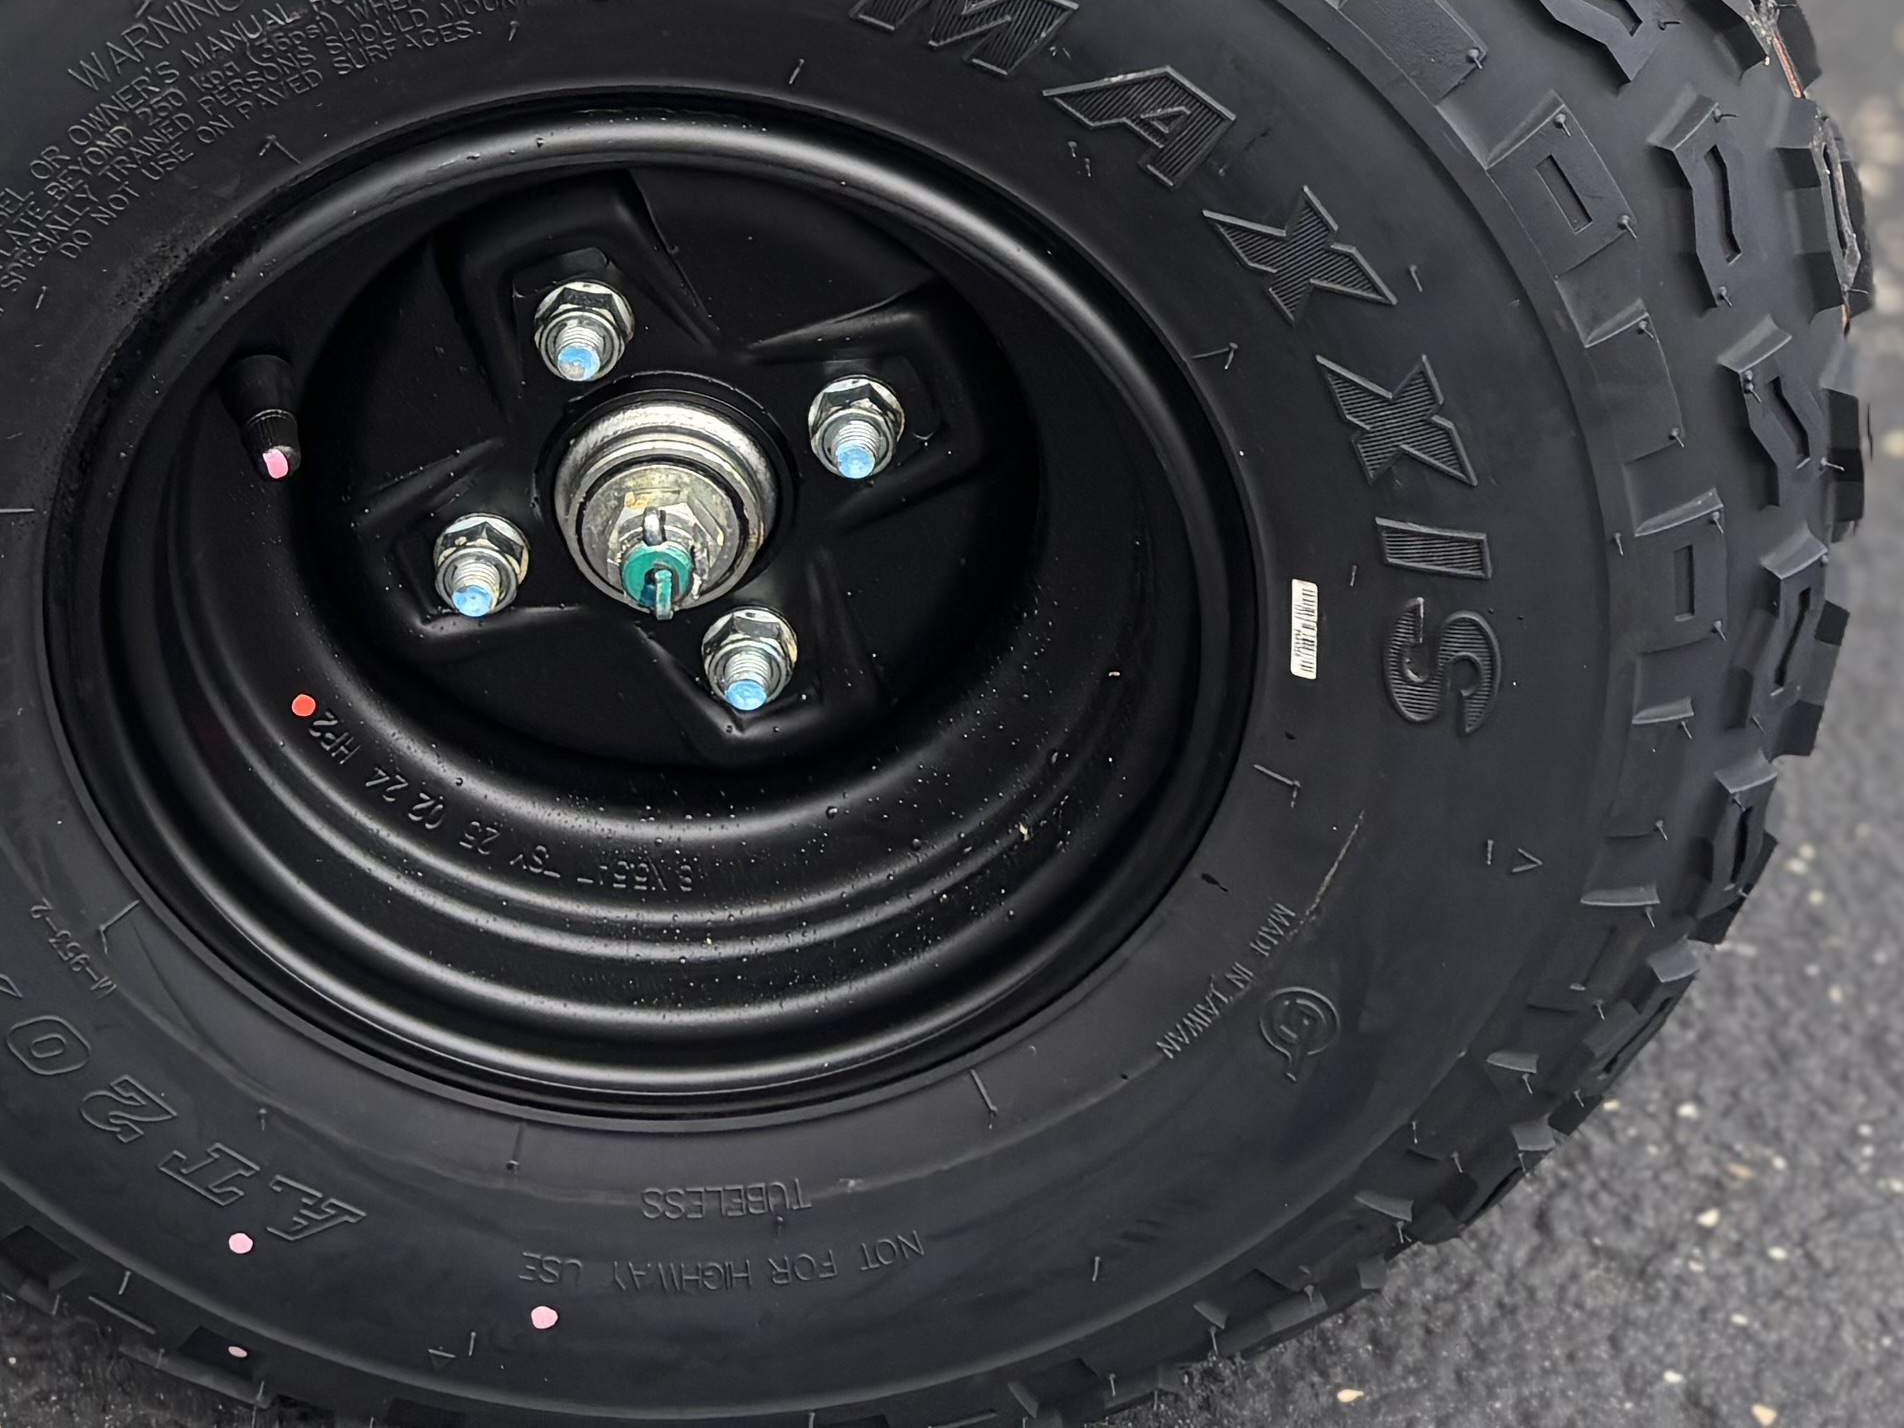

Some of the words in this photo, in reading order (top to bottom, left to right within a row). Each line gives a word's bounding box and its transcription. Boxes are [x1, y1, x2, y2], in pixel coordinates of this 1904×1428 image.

[26, 144, 70, 181] OR
[65, 59, 181, 146] OWNER'S
[182, 0, 299, 66] MANUAL
[98, 110, 196, 185] TRAINED
[198, 46, 317, 113] PERSONS
[322, 7, 430, 54] SHOULD
[44, 123, 136, 201] BEYOND
[135, 86, 189, 126] 250
[58, 226, 95, 258] DO
[90, 181, 143, 225] NOT
[142, 141, 194, 180] USE
[193, 113, 235, 145] ON
[236, 66, 325, 120] PAVED
[331, 17, 481, 75] SURFACES.
[304, 711, 364, 764] HP2
[1247, 903, 1298, 957] MADE
[1223, 962, 1254, 987] IN
[1154, 985, 1233, 1058] TAIWAN
[641, 1177, 811, 1216] TUBELESS
[517, 1252, 580, 1284] USE
[613, 1260, 751, 1289] HIGHWAY
[769, 1249, 837, 1283] FOR
[854, 1230, 925, 1269] NOT
